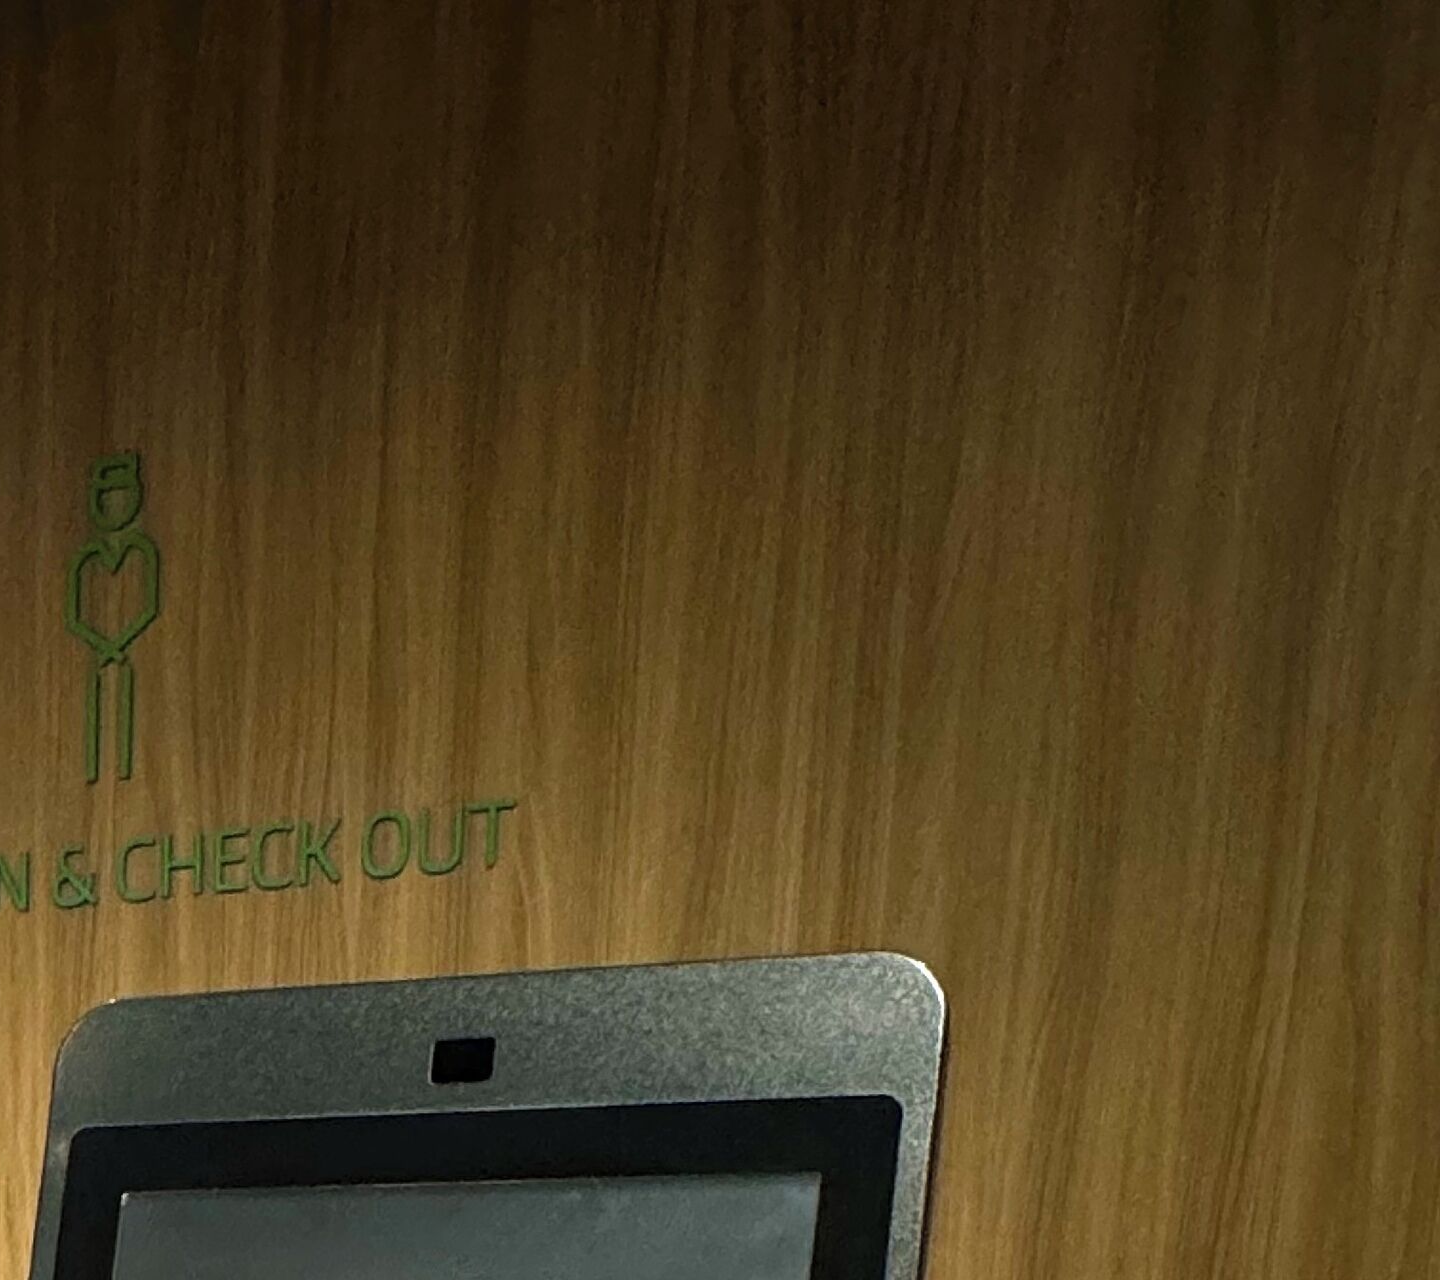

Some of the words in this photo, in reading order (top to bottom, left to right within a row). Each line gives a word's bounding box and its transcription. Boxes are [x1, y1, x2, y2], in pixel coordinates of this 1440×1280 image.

[51, 845, 98, 908] &
[116, 815, 343, 905] CHECK
[360, 800, 516, 882] OUT
